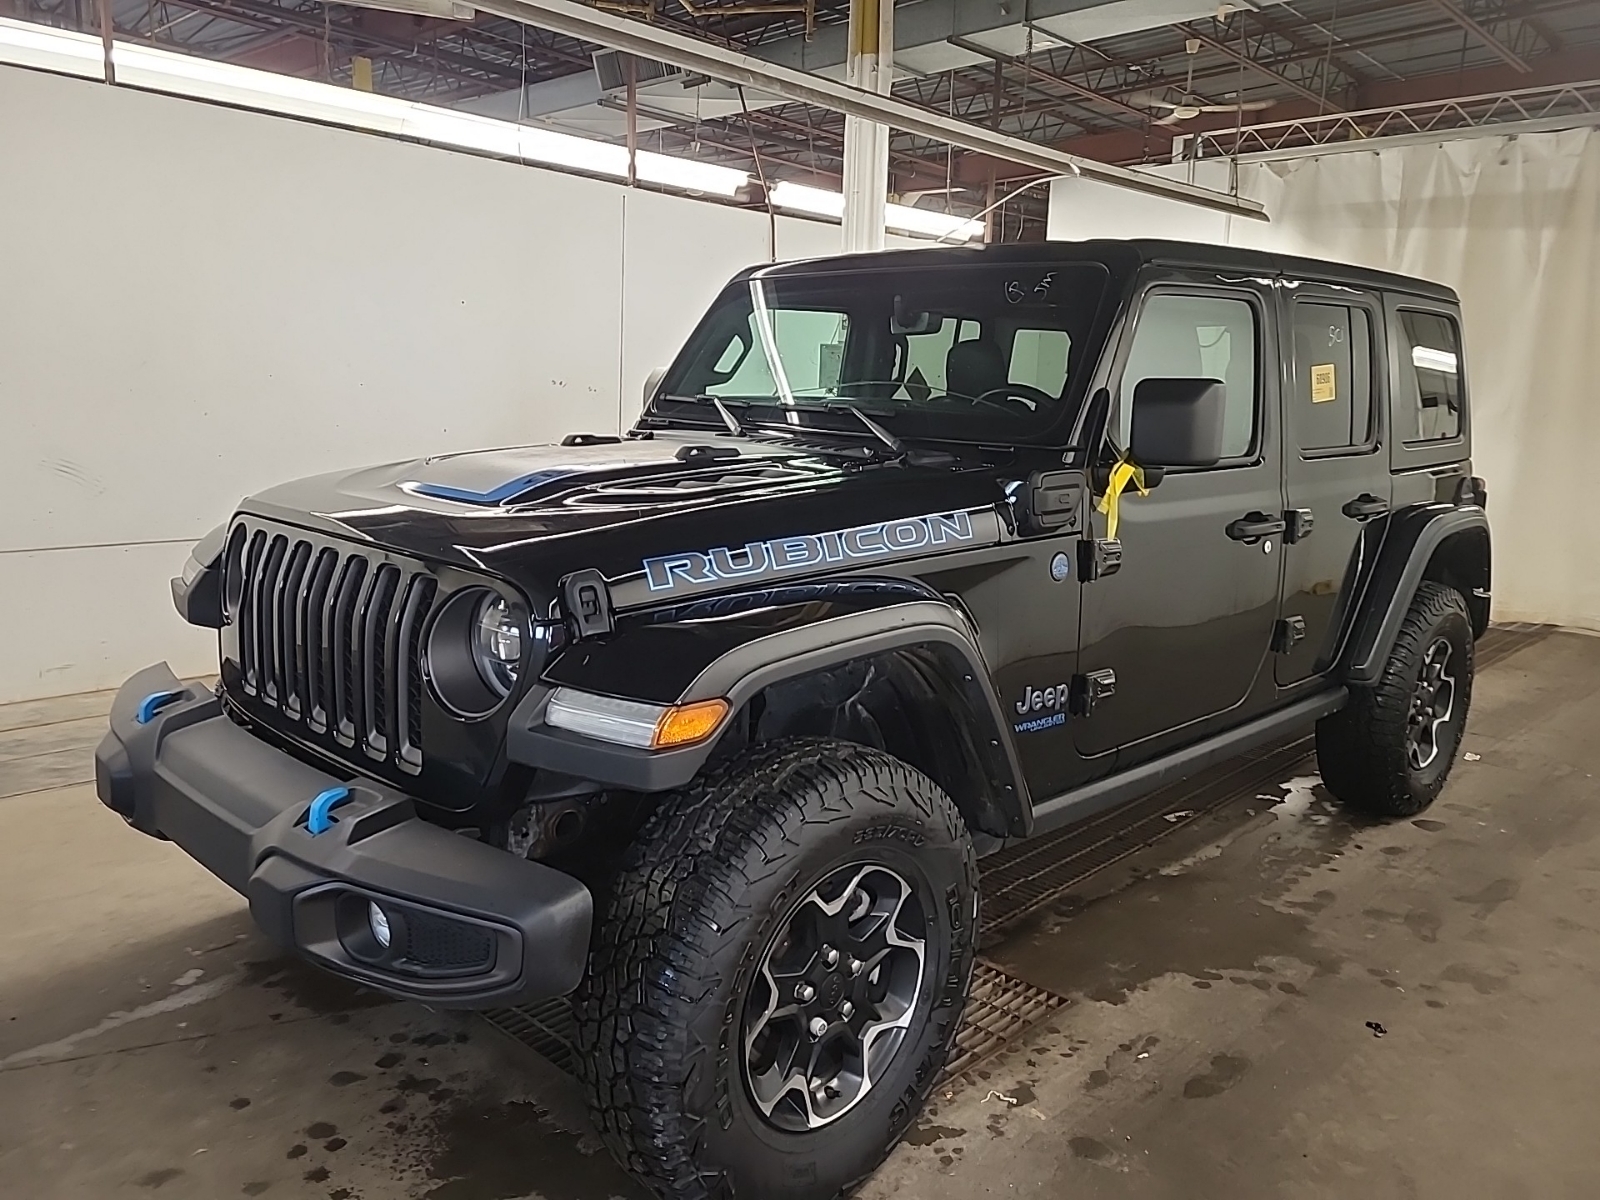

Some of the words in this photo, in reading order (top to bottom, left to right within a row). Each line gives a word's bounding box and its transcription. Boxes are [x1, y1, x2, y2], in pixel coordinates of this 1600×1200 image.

[643, 512, 973, 591] RUBICON
[1016, 684, 1069, 714] Jeep
[1014, 712, 1066, 732] WRANGLER
